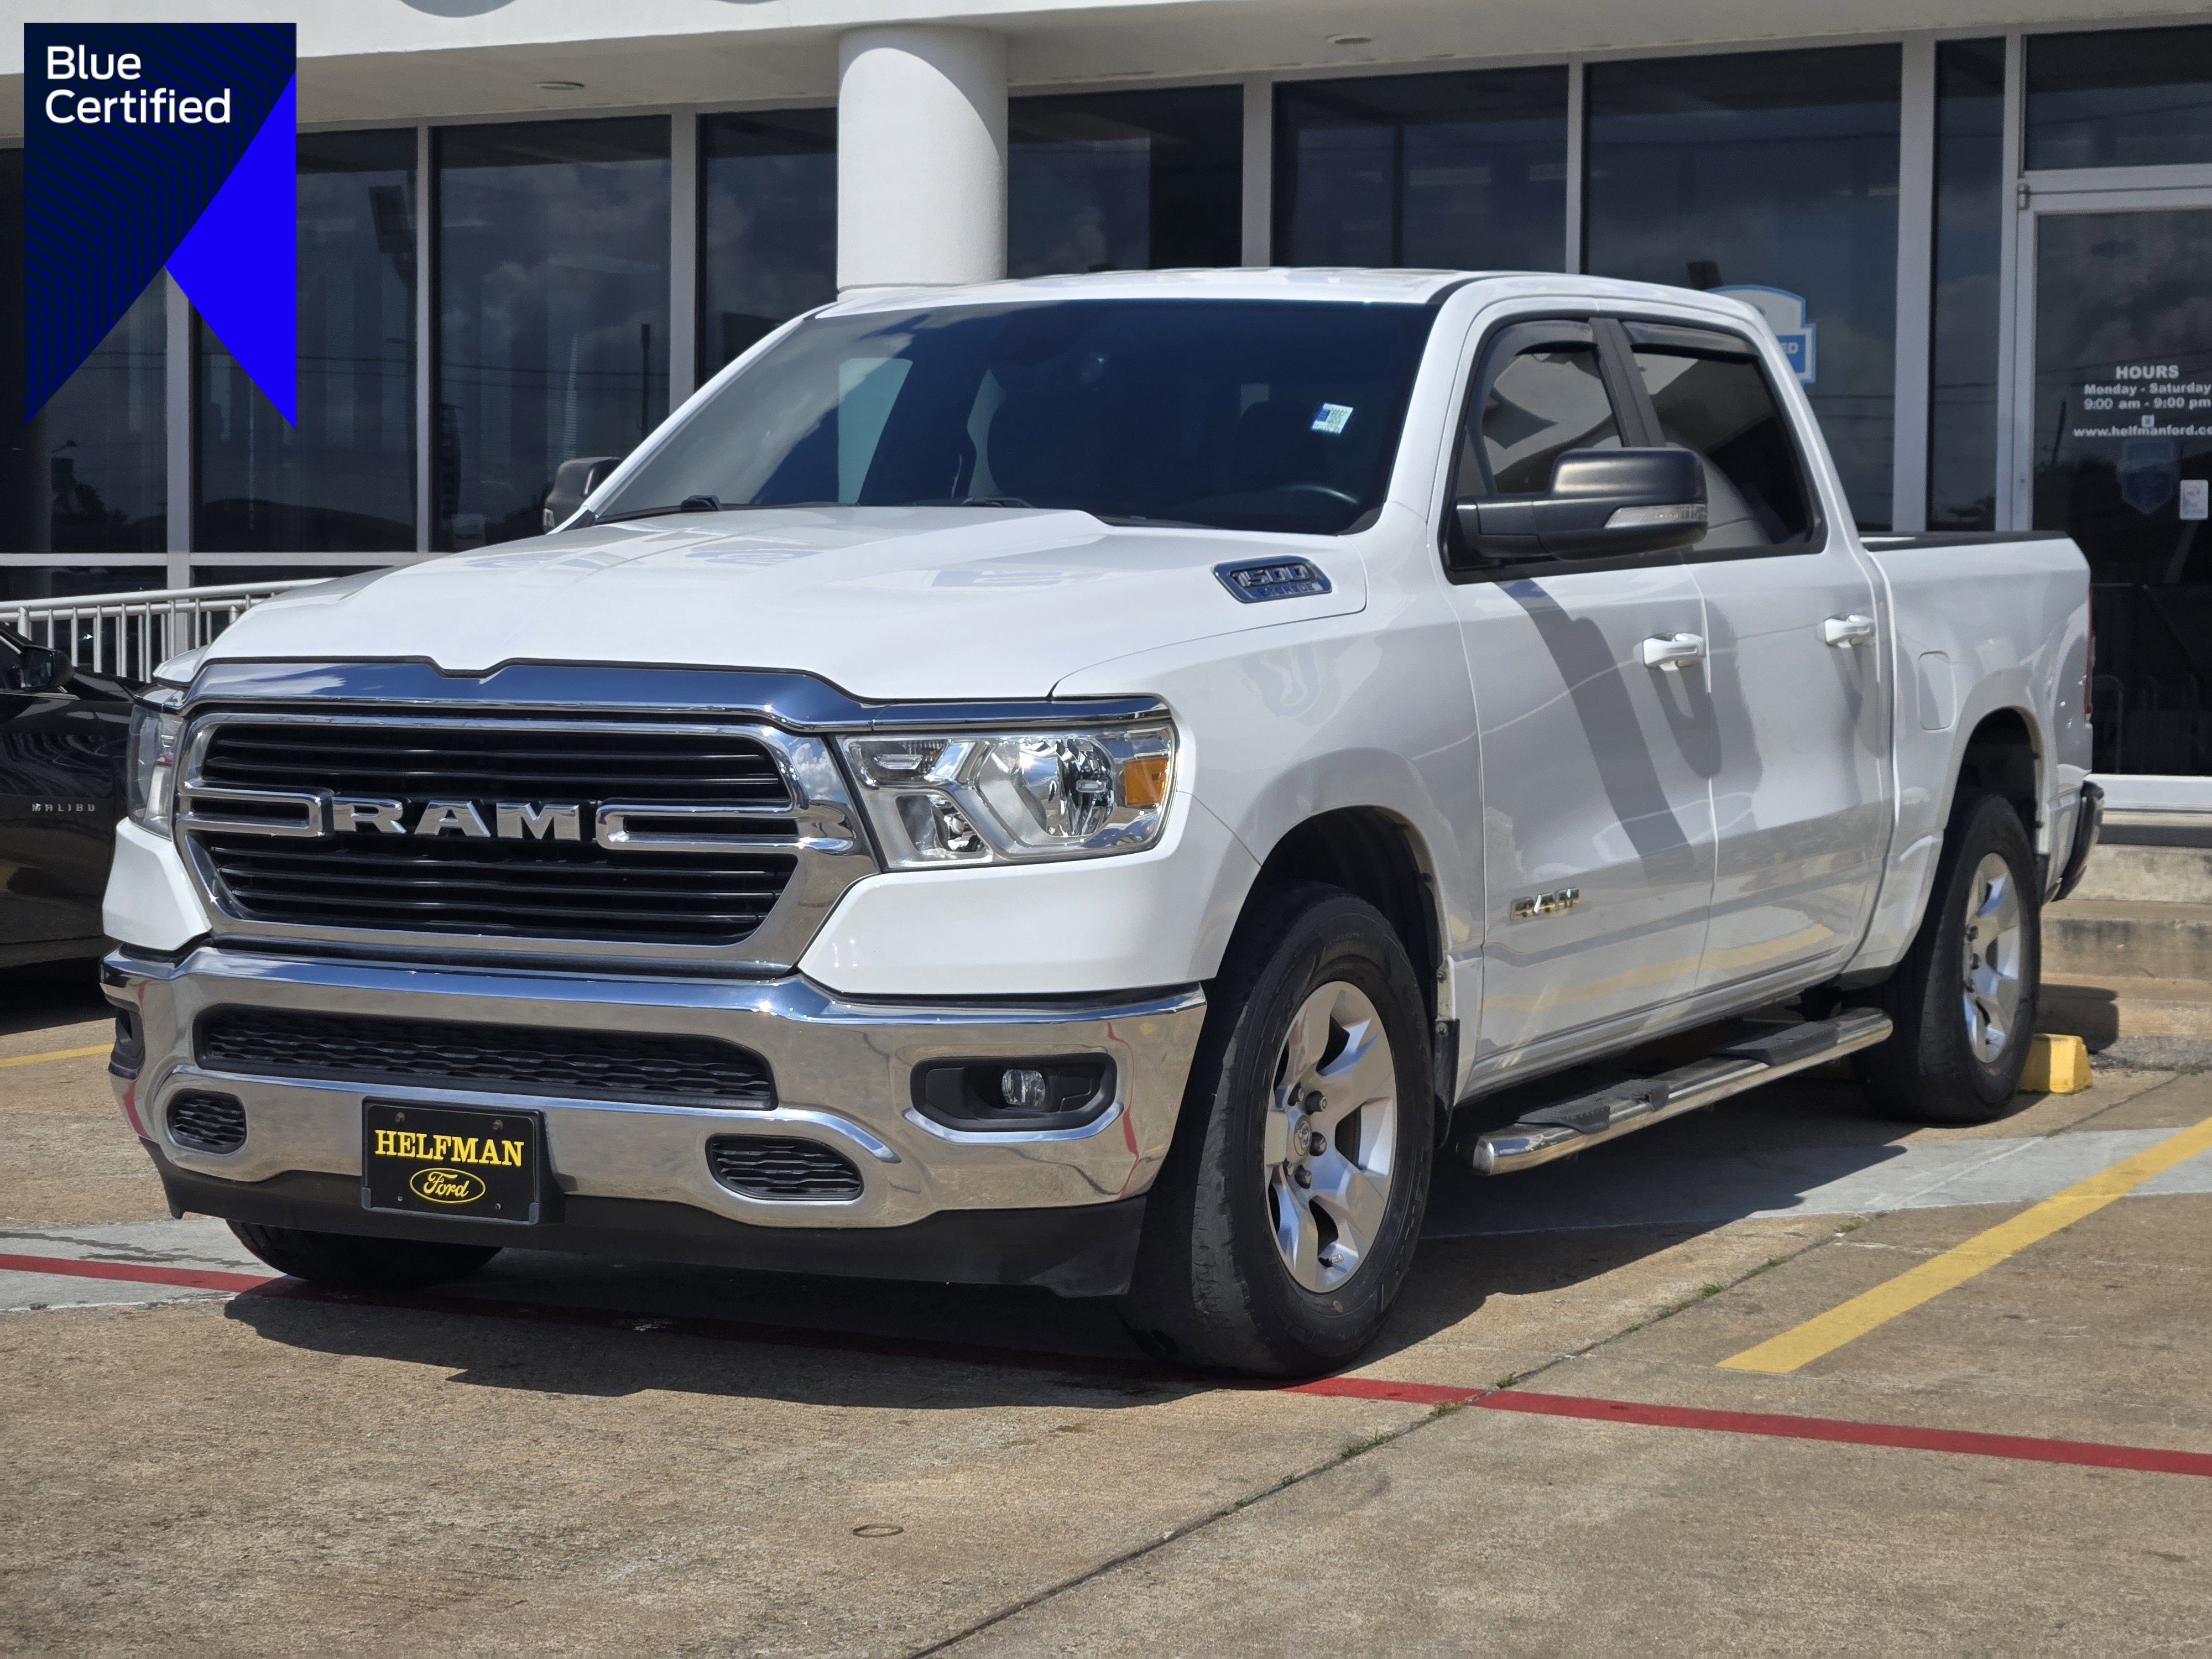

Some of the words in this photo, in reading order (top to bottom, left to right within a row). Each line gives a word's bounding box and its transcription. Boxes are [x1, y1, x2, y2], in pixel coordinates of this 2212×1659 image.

[2115, 365, 2179, 379] HOURS
[2084, 384, 2137, 397] Monday
[2149, 382, 2211, 395] Saturday
[2084, 398, 2114, 410] 9:00
[2118, 400, 2141, 409] am
[2154, 397, 2185, 409] 9:00
[2189, 398, 2211, 410] pm
[1231, 564, 1311, 586] 1500
[32, 804, 96, 812] MALIBU
[332, 796, 580, 841] RAM
[374, 1130, 524, 1167] HELFMAN
[422, 1171, 470, 1198] Ford
